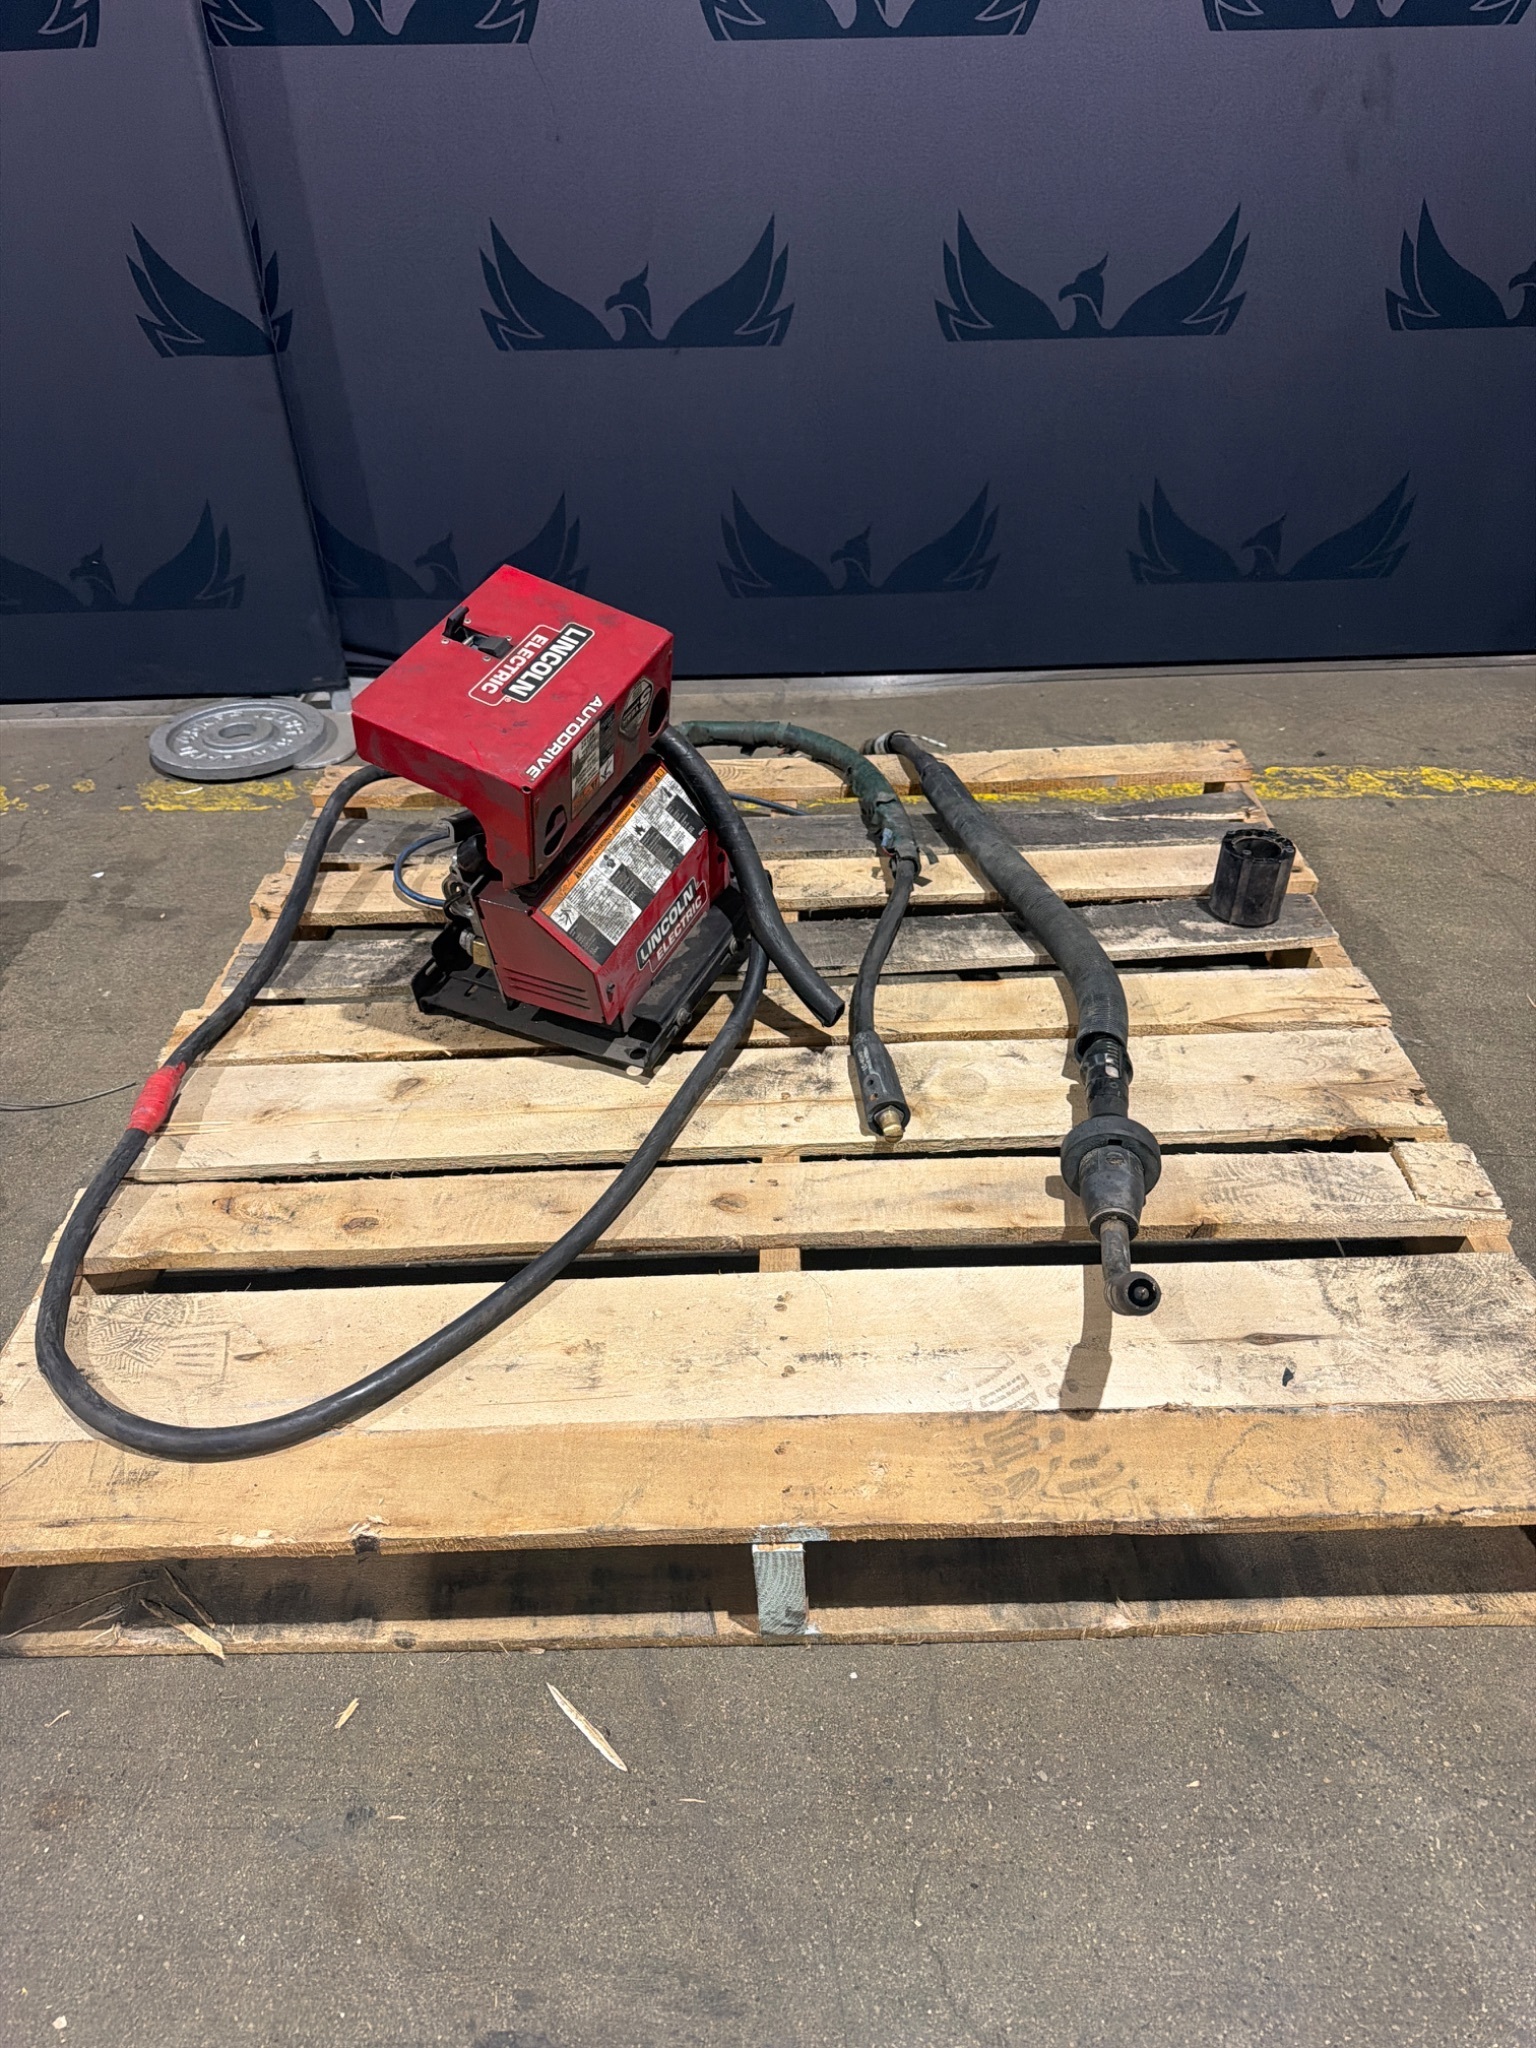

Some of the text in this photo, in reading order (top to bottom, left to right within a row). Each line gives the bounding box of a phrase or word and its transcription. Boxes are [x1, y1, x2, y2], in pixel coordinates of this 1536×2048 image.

[481, 633, 549, 695] ELECTRIC
[508, 627, 588, 698] LINCOLN
[525, 695, 604, 779] AUTODRIVE
[639, 884, 696, 963] LINCOLN
[656, 895, 702, 961] ELECTRIC
